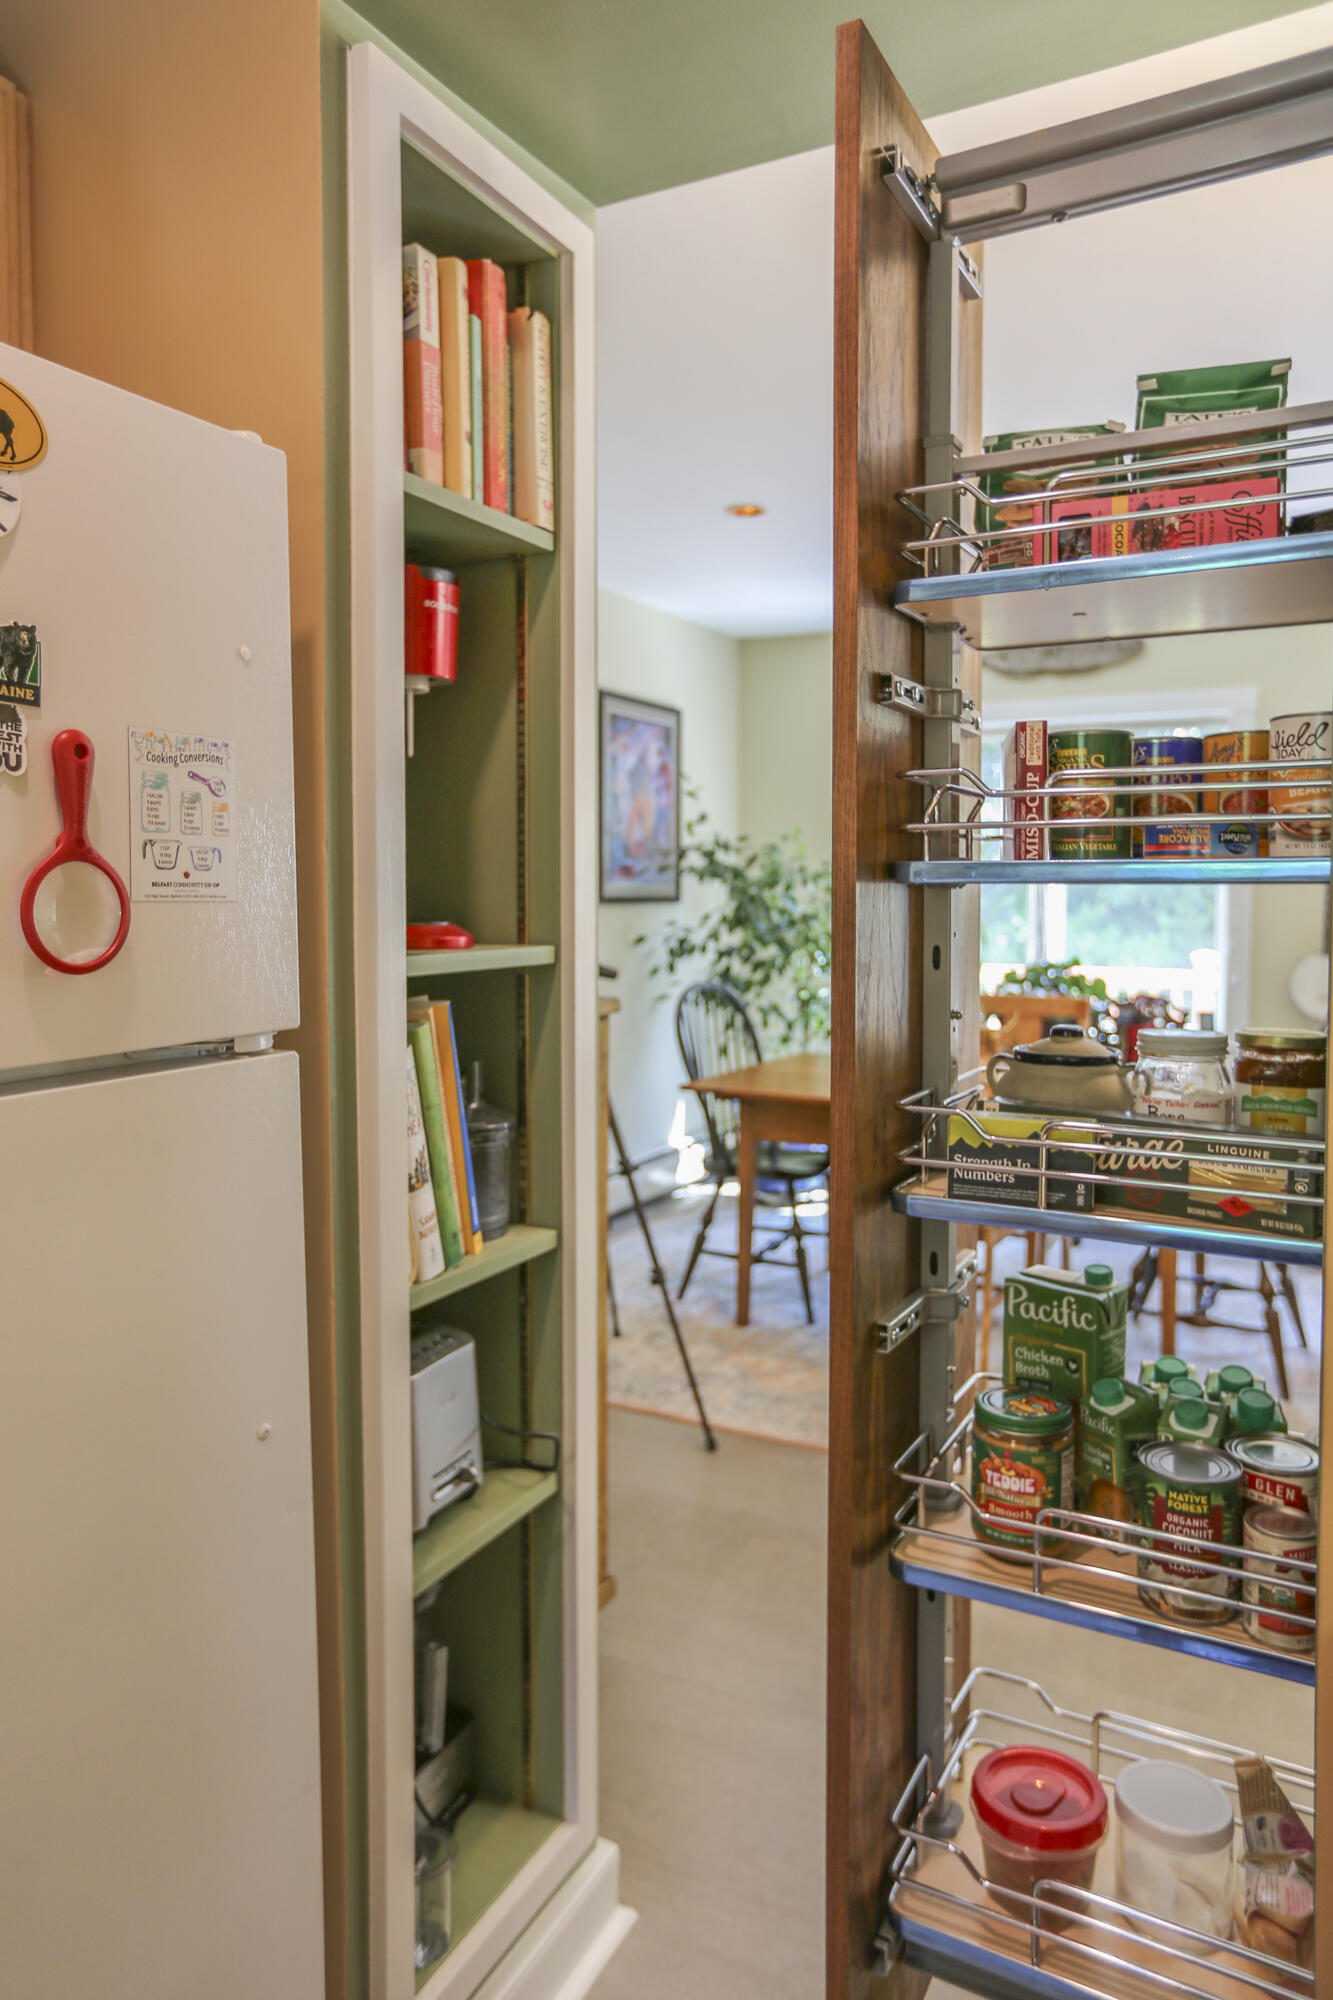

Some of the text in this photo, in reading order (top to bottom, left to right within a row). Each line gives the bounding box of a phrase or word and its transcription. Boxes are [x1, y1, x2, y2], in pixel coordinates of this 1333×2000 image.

[1178, 495, 1196, 547] BSCUI
[1115, 520, 1124, 556] OCOA
[0, 684, 35, 700] AINE
[0, 741, 22, 753] ITH
[1271, 721, 1329, 759] field
[146, 751, 224, 768] Cooking Conversions
[1281, 748, 1304, 760] DAY
[1207, 1143, 1271, 1160] LINGUINE
[953, 1167, 1015, 1184] Numbers
[1005, 1282, 1097, 1331] Pacific
[1014, 1346, 1064, 1367] Chicken
[1015, 1361, 1049, 1379] Broth
[1080, 1404, 1116, 1437] Pacific
[985, 1468, 1036, 1494] TEDDIE
[1255, 1477, 1296, 1502] GLEN
[1168, 1489, 1208, 1505] NATIVE
[988, 1501, 1033, 1521] Smooth
[1167, 1499, 1209, 1515] FOREST
[1166, 1512, 1209, 1529] ORGANIC
